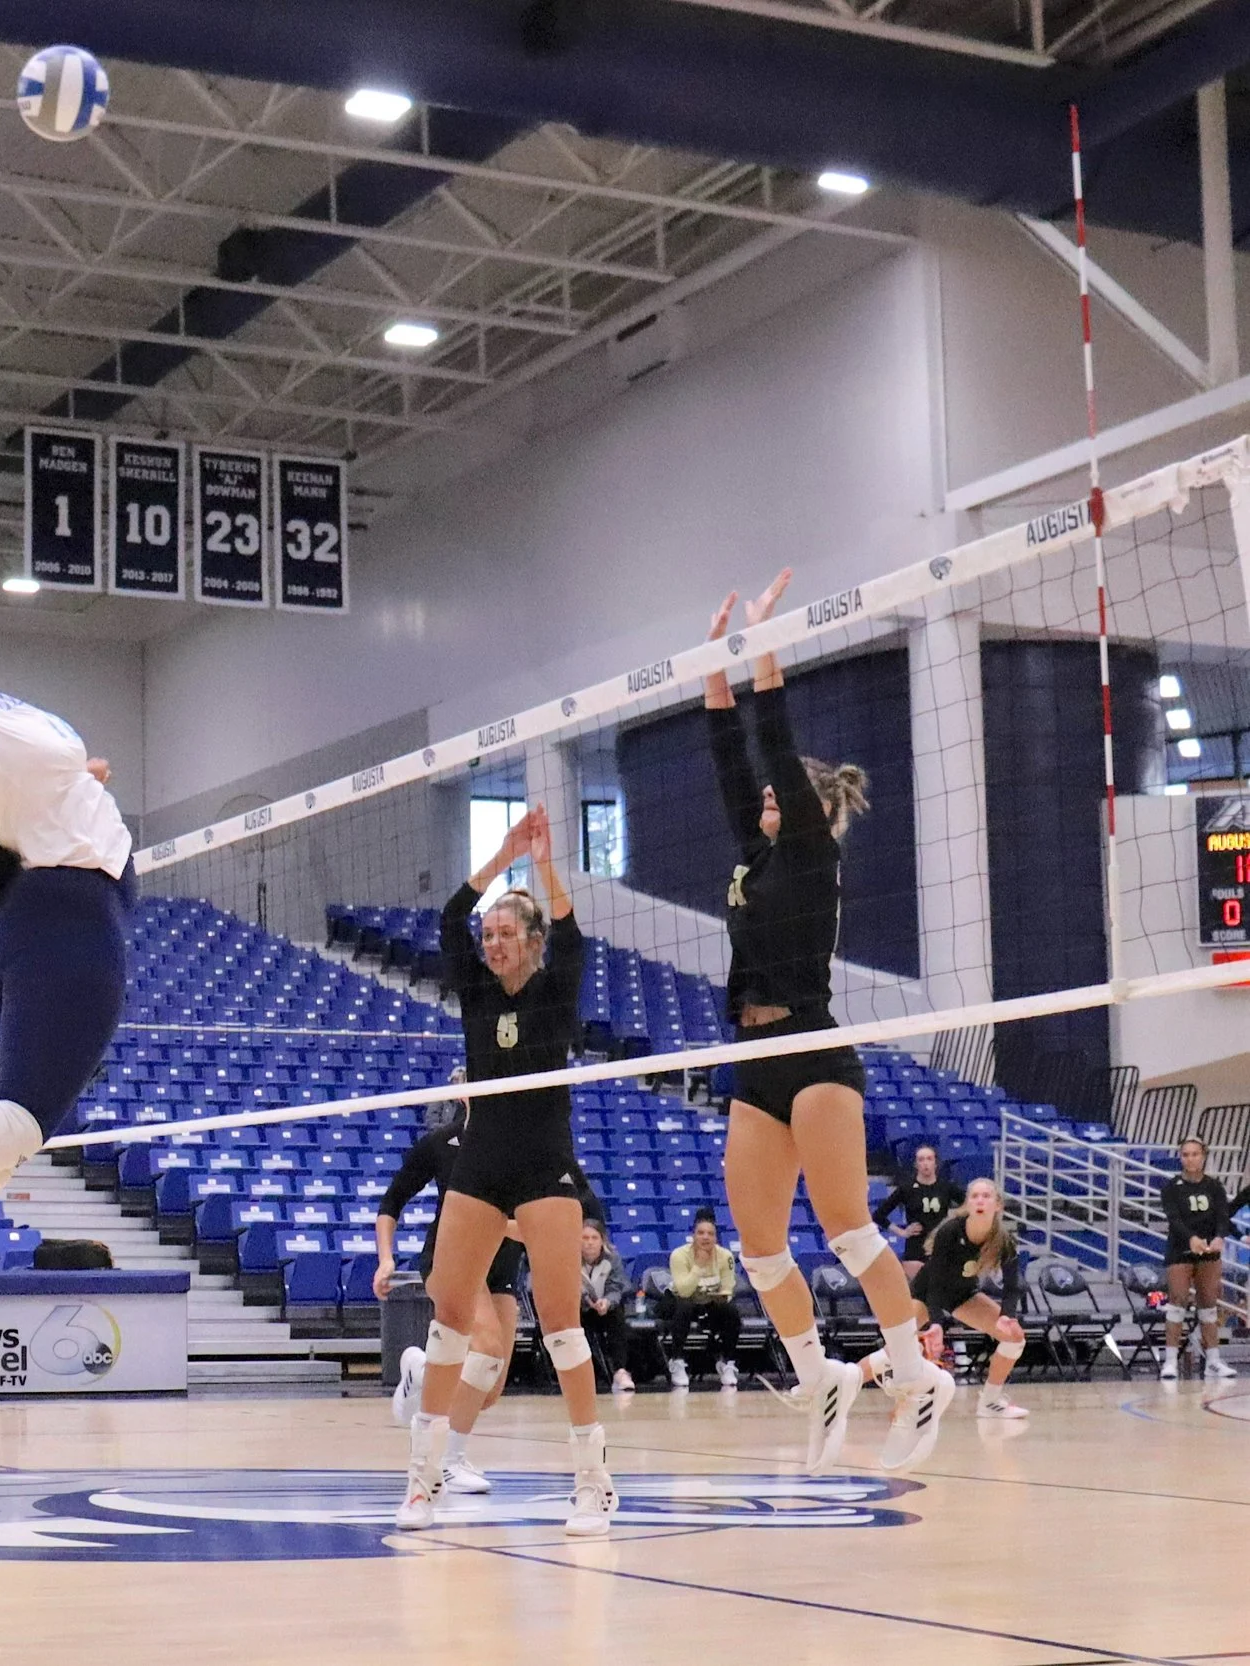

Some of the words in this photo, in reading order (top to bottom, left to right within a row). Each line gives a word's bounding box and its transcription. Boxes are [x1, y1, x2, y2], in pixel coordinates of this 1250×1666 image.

[55, 495, 72, 537] 1
[126, 502, 171, 546] 10
[205, 510, 260, 556] 23
[1027, 500, 1091, 547] AUGUST
[286, 519, 339, 563] 32
[807, 587, 864, 630] AUGUSTA
[627, 659, 674, 695] AUGUSTA
[477, 718, 516, 749] AUGUSTA
[352, 766, 385, 792] AUGUSTA
[1224, 900, 1241, 926] 0
[1211, 929, 1246, 942] SCORE
[496, 1012, 518, 1048] 6
[922, 1197, 940, 1213] 14
[82, 1350, 112, 1365] abc
